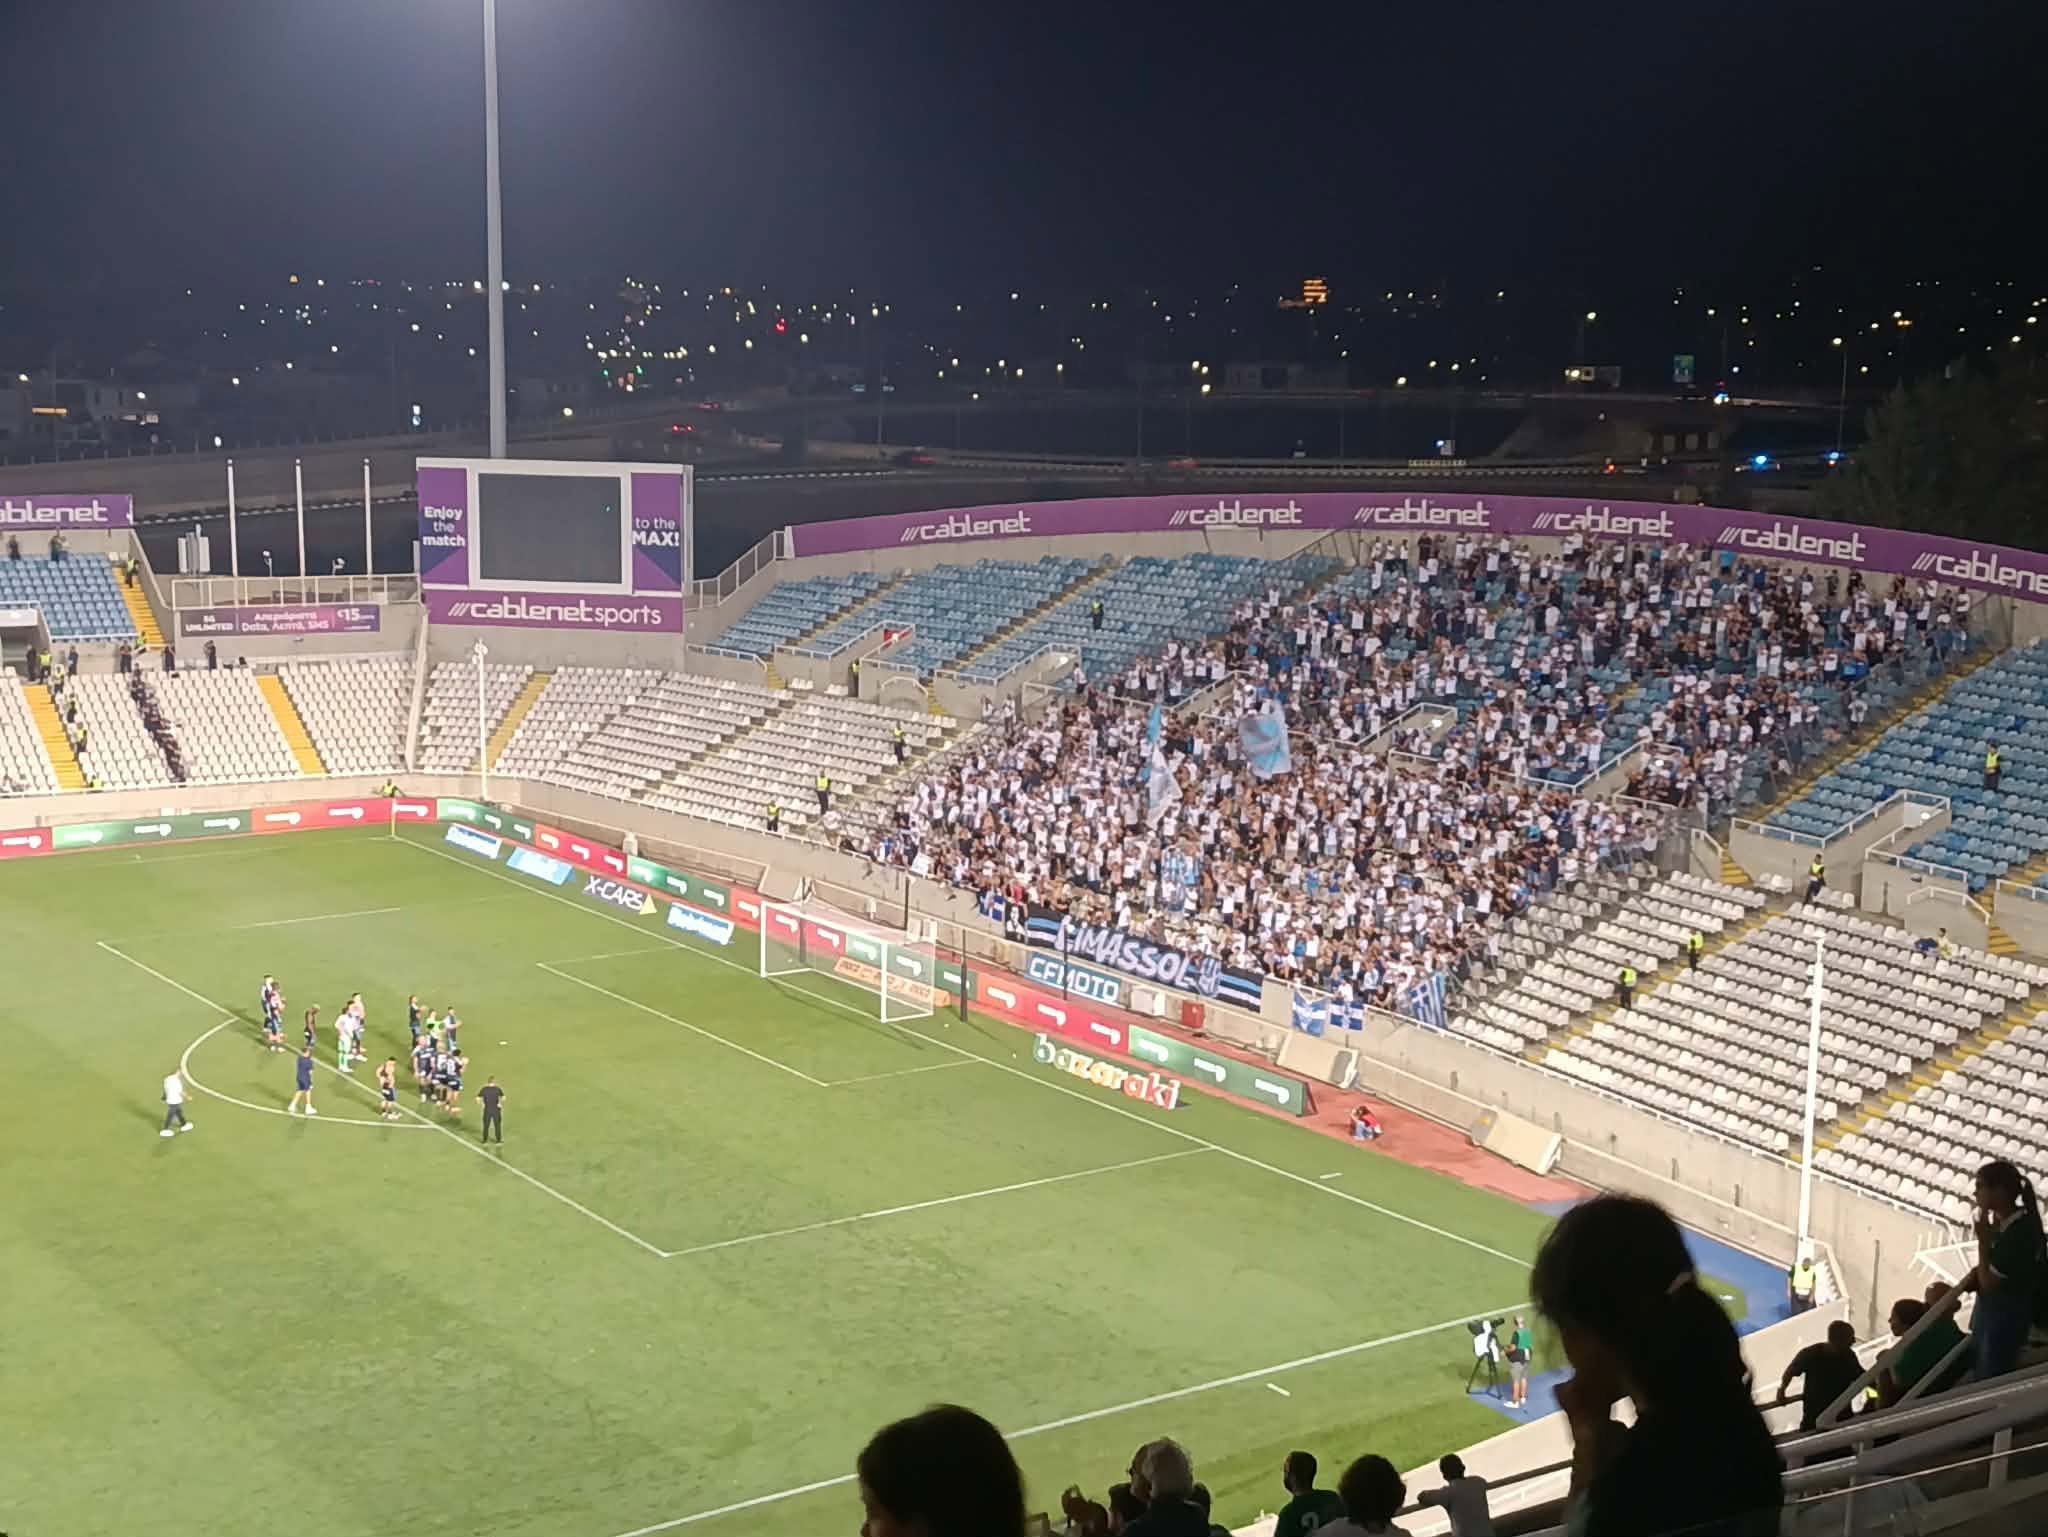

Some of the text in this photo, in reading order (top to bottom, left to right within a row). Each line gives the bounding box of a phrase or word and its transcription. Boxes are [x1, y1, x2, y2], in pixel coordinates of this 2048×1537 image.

[0, 500, 108, 522] blenet
[424, 506, 463, 521] Enjoy
[635, 517, 675, 530] to the
[920, 510, 1032, 540] cablenet
[1189, 500, 1303, 524] cablenet
[1374, 498, 1490, 527] cablenet
[1554, 505, 1674, 537] cablenet
[423, 535, 466, 547] match
[433, 521, 455, 533] the
[632, 531, 680, 547] MAX!
[1740, 522, 1867, 562] cablenet
[470, 596, 662, 627] cablenetsports
[584, 875, 643, 911] X-CARS
[1054, 914, 1195, 988] LIMASSOL
[1030, 957, 1119, 1001] CFMOTO
[1033, 1033, 1181, 1110] bazaraki
